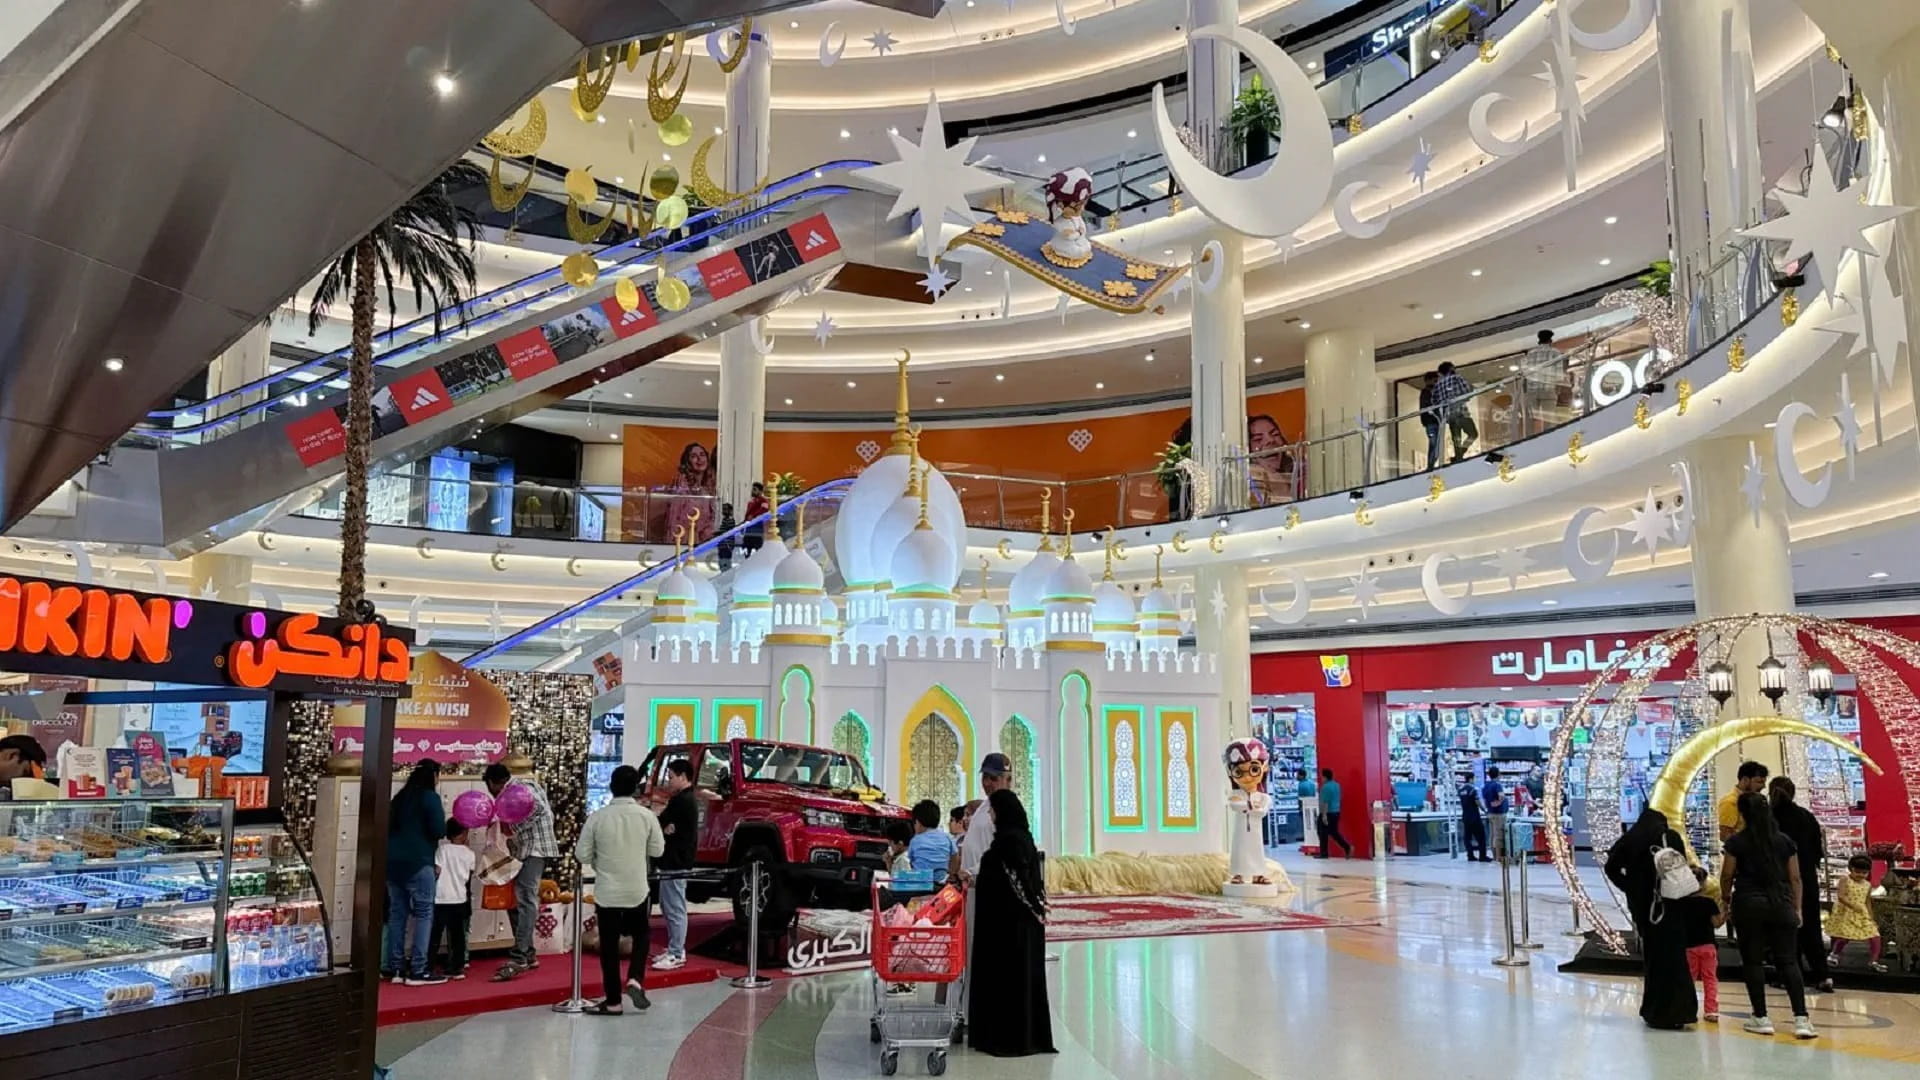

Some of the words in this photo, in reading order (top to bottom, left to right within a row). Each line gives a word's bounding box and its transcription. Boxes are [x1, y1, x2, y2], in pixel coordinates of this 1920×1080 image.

[229, 609, 409, 688] دانكن
[396, 701, 421, 716] AKE
[424, 701, 433, 716] A
[434, 702, 470, 717] WISH
[32, 719, 78, 728] DISCOUNT
